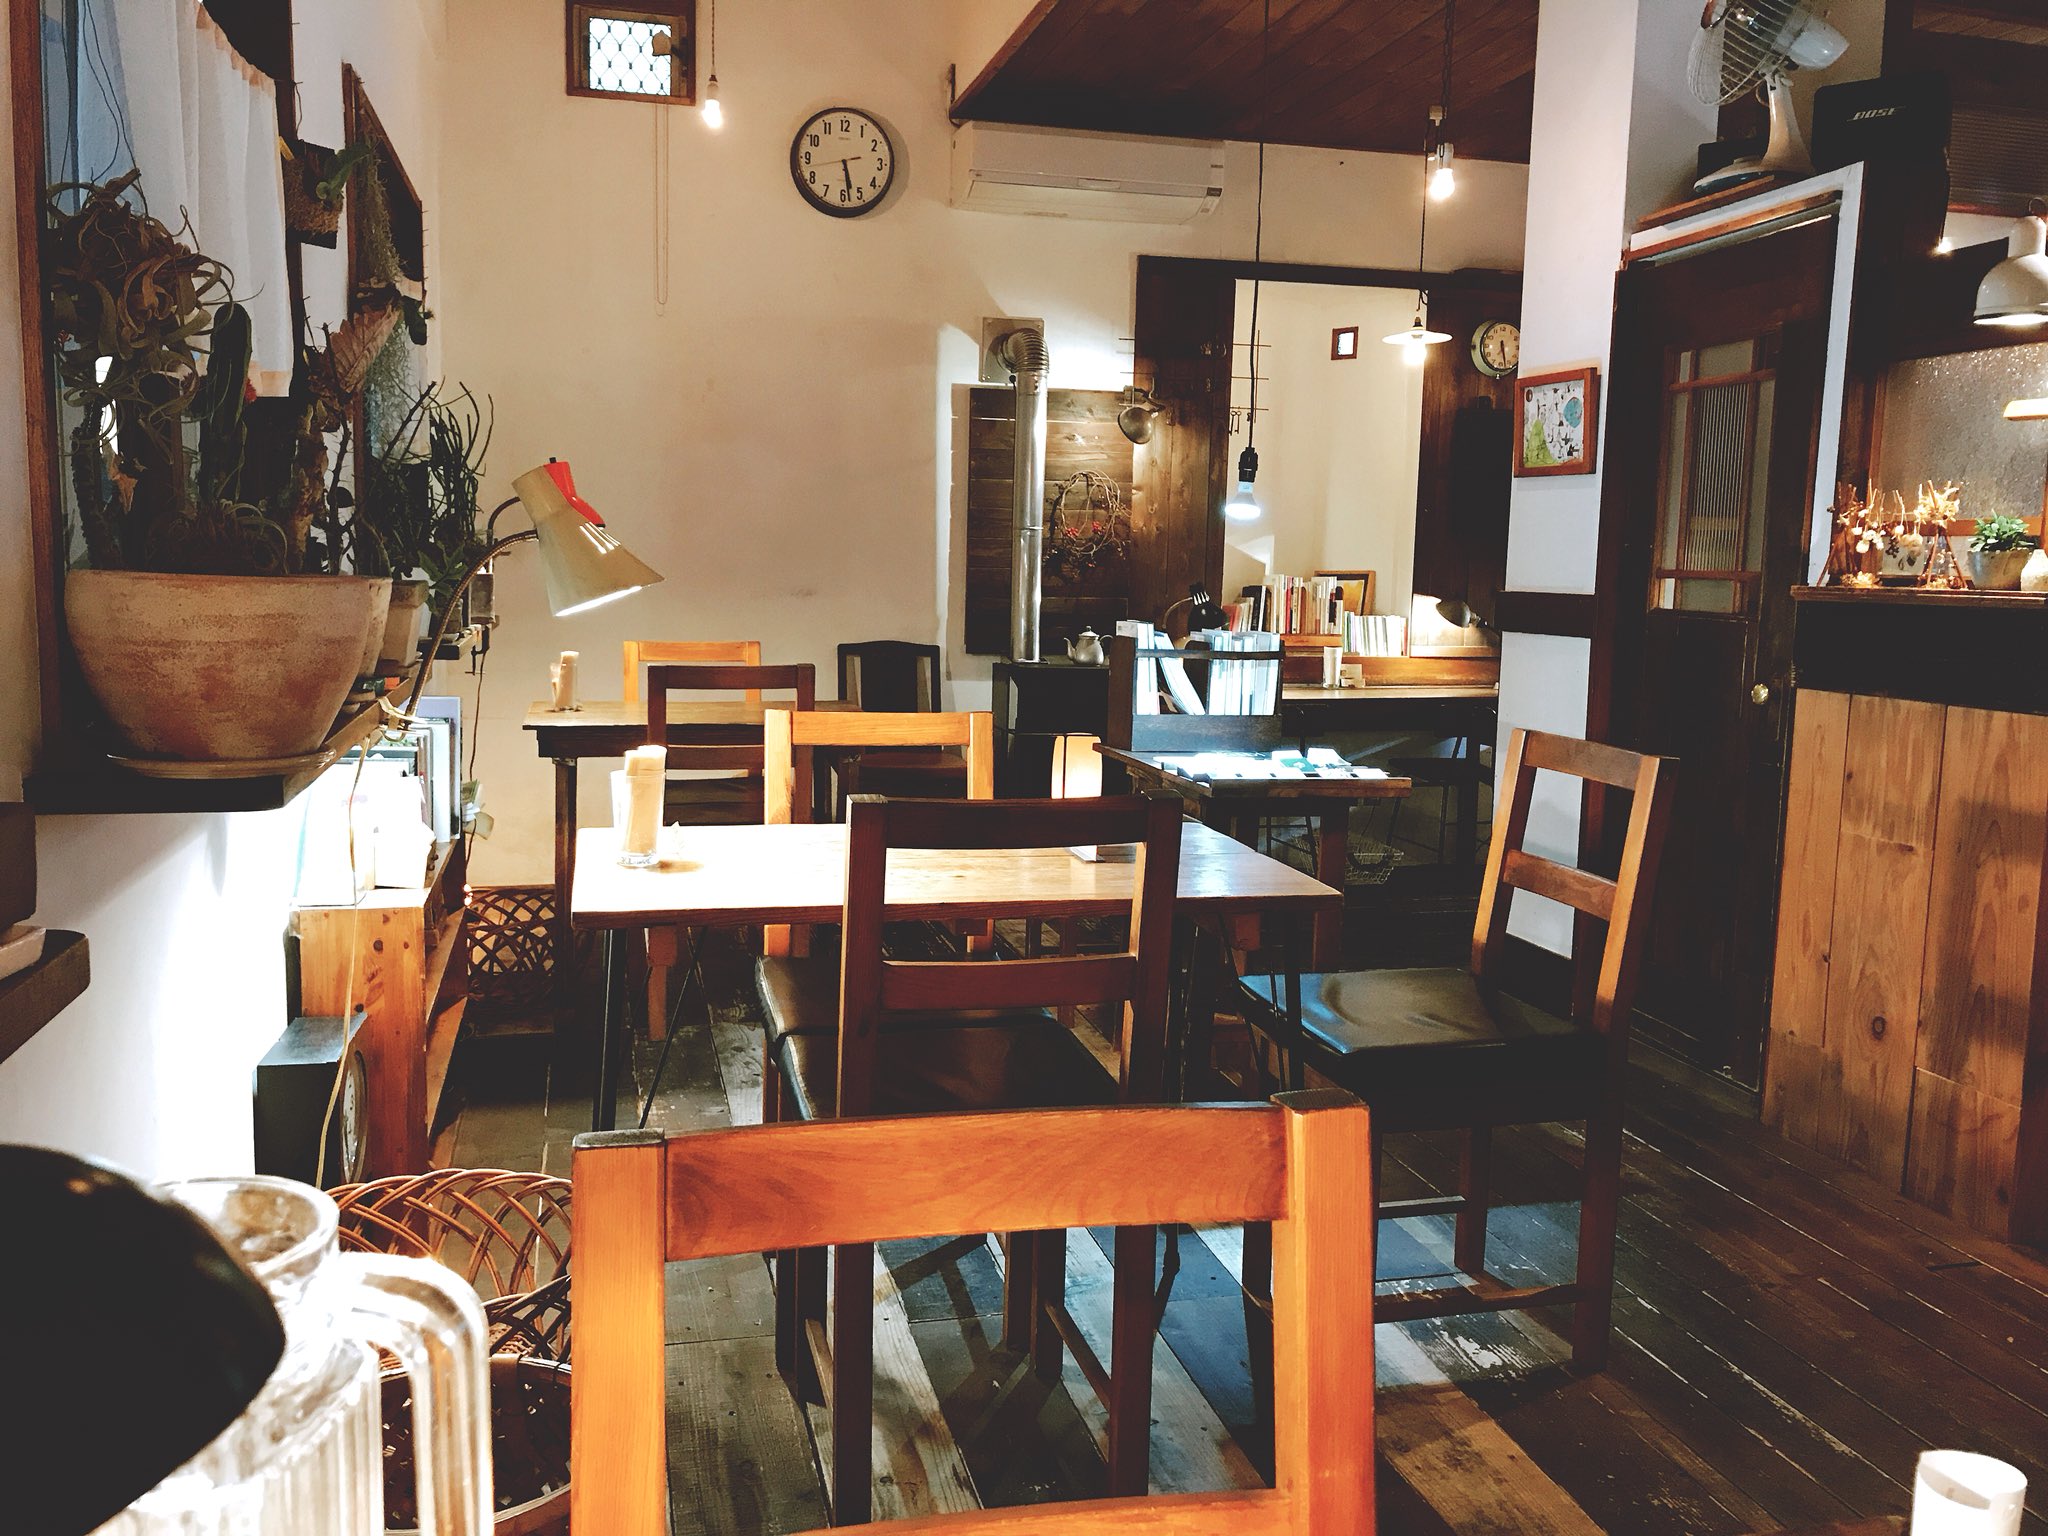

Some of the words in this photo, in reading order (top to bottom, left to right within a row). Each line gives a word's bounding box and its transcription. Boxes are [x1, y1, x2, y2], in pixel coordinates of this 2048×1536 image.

[1852, 107, 1896, 121] BOSE
[824, 122, 832, 135] 11
[840, 119, 851, 132] 12
[809, 134, 820, 147] 10
[871, 139, 878, 152] 2
[804, 151, 811, 165] 9
[876, 158, 883, 171] 3
[809, 171, 816, 184] 8
[870, 176, 877, 189] 4
[823, 184, 830, 197] 7
[840, 189, 846, 203] 6
[856, 187, 863, 200] 5
